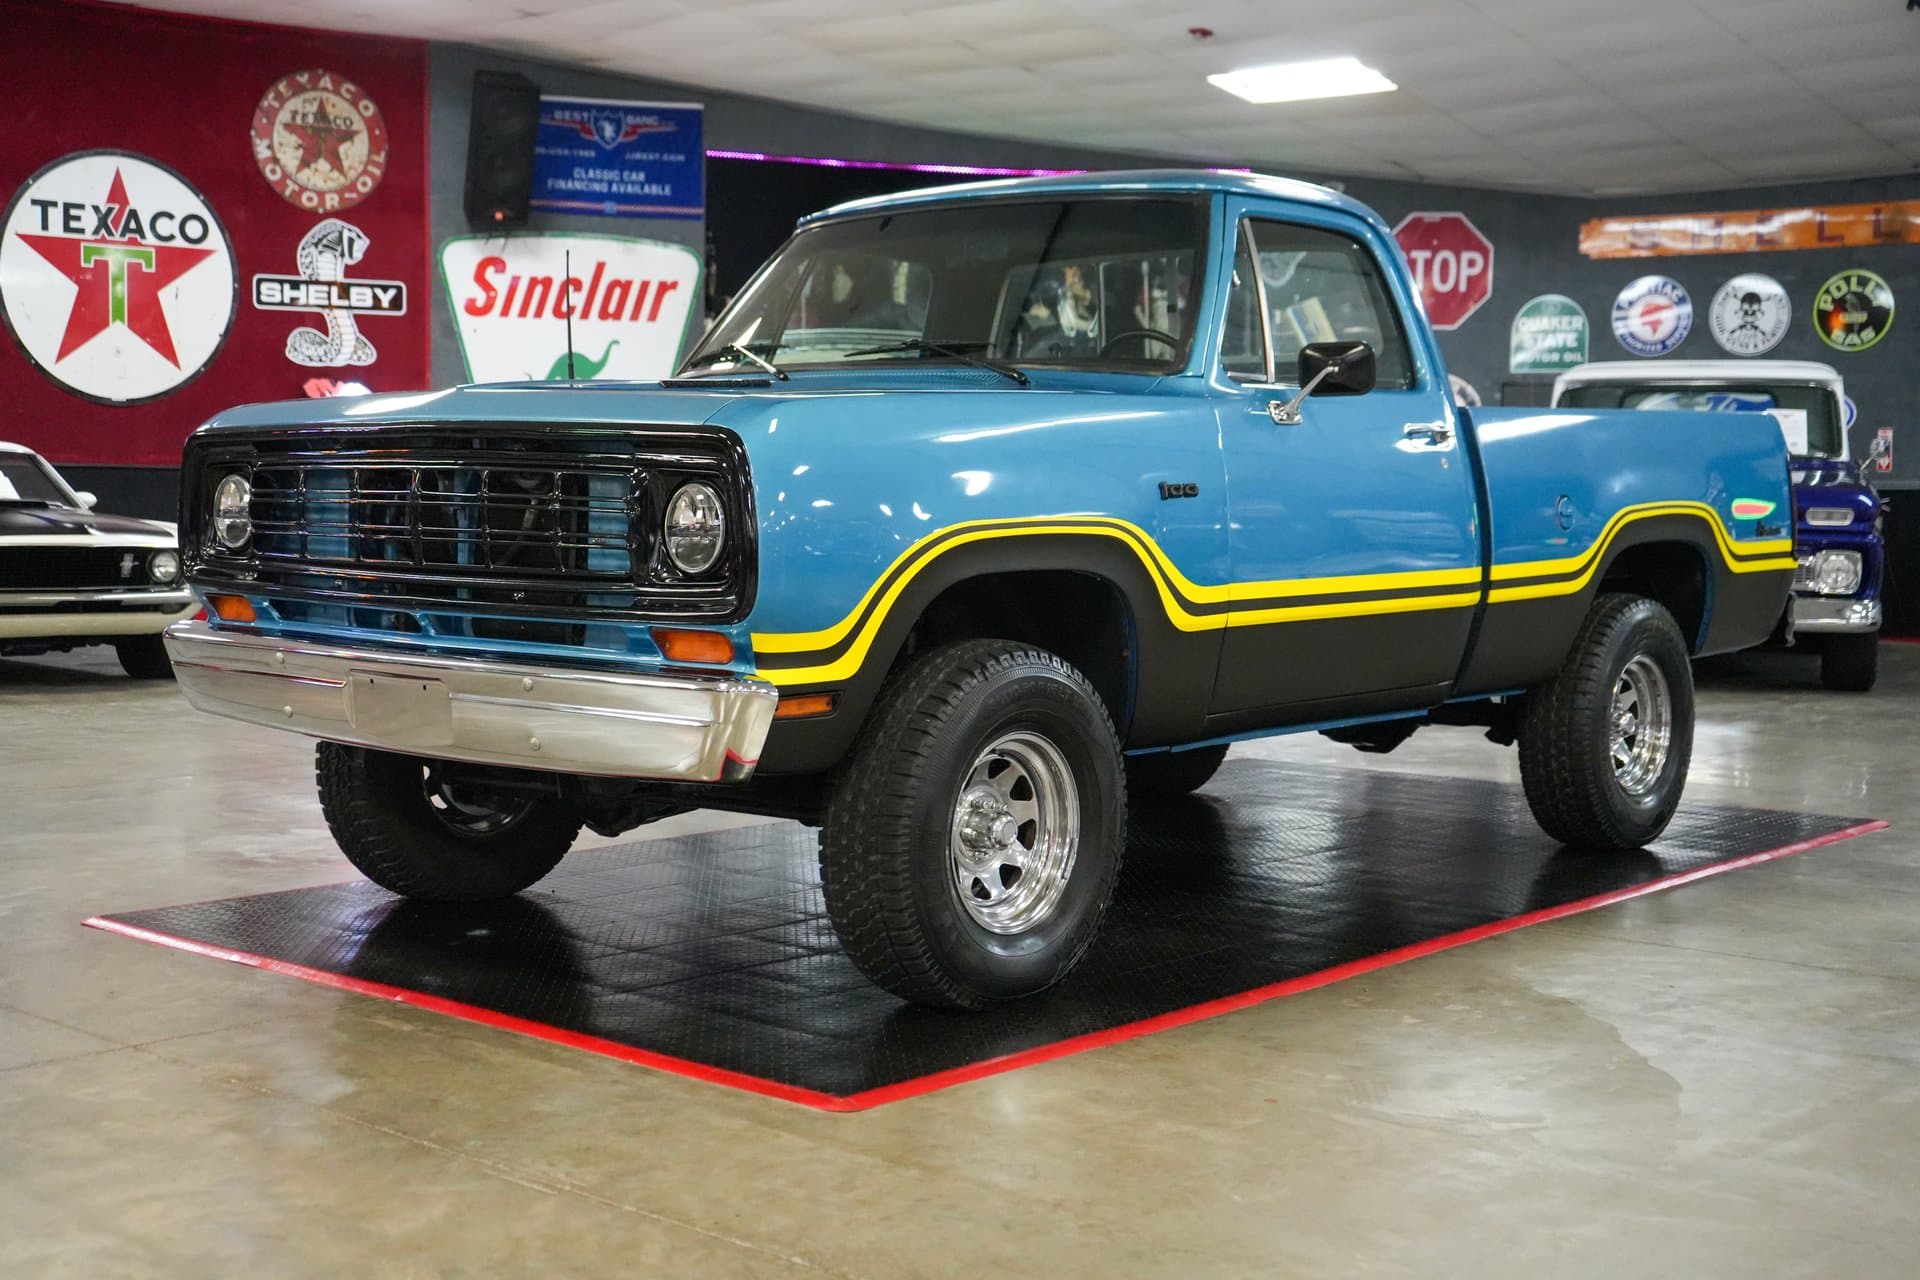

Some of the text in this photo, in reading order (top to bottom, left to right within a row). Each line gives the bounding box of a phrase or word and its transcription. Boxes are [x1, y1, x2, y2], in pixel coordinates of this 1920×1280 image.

[573, 167, 646, 182] CLASSIC CAR
[547, 178, 672, 197] FINANCING AVAILABLE
[31, 198, 210, 245] TEXACO
[1409, 249, 1485, 294] TOP
[81, 244, 155, 325] T
[464, 256, 679, 322] Sinclair
[259, 281, 397, 308] SHELBY
[1517, 316, 1584, 331] QUAKER
[1523, 332, 1579, 348] STATE
[1831, 327, 1876, 346] GAS
[1563, 350, 1584, 363] OIL
